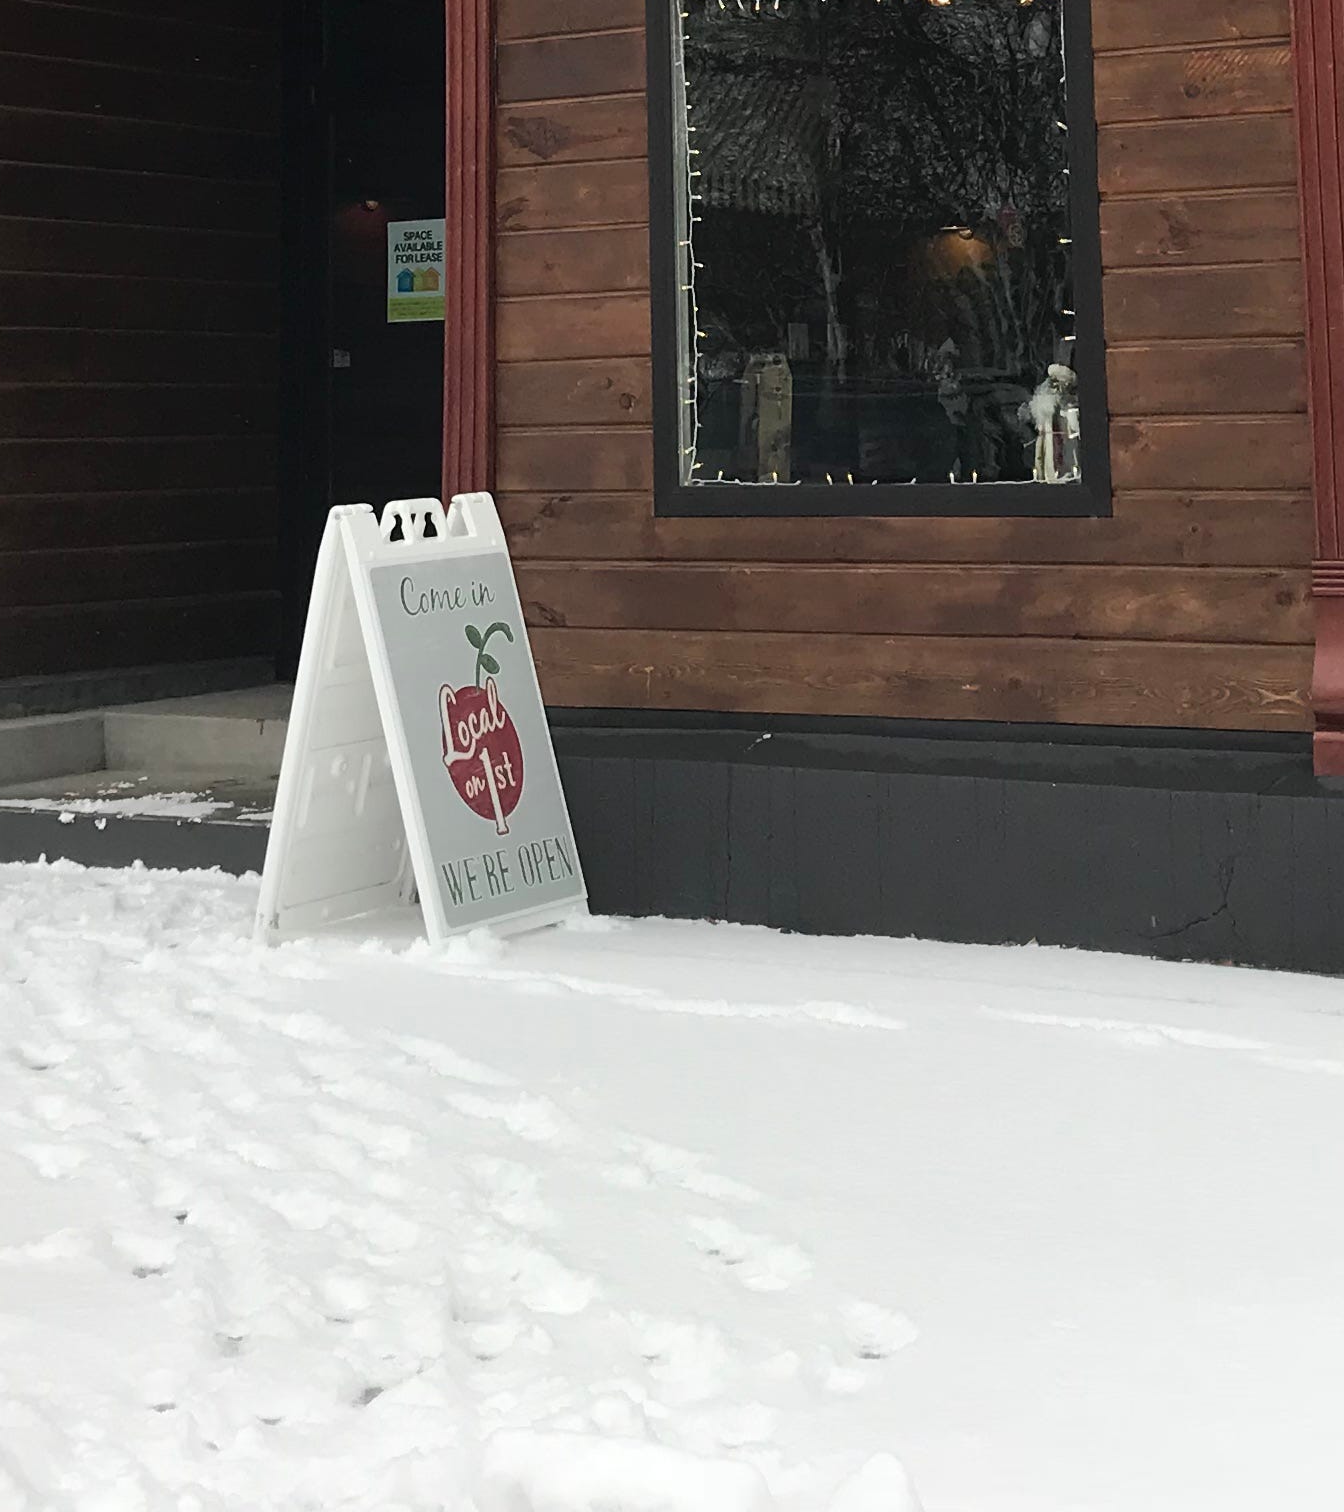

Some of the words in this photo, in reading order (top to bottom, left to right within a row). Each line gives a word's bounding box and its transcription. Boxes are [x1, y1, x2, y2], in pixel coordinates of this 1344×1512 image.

[394, 241, 443, 252] AVAILABLE
[403, 230, 433, 241] SPACE
[395, 254, 413, 264] FOR
[415, 252, 443, 263] LEASE
[400, 576, 467, 616] Come
[471, 581, 495, 606] in
[440, 677, 506, 767] Local
[465, 775, 485, 799] on
[479, 747, 516, 835] 1st
[518, 836, 574, 887] OPEN
